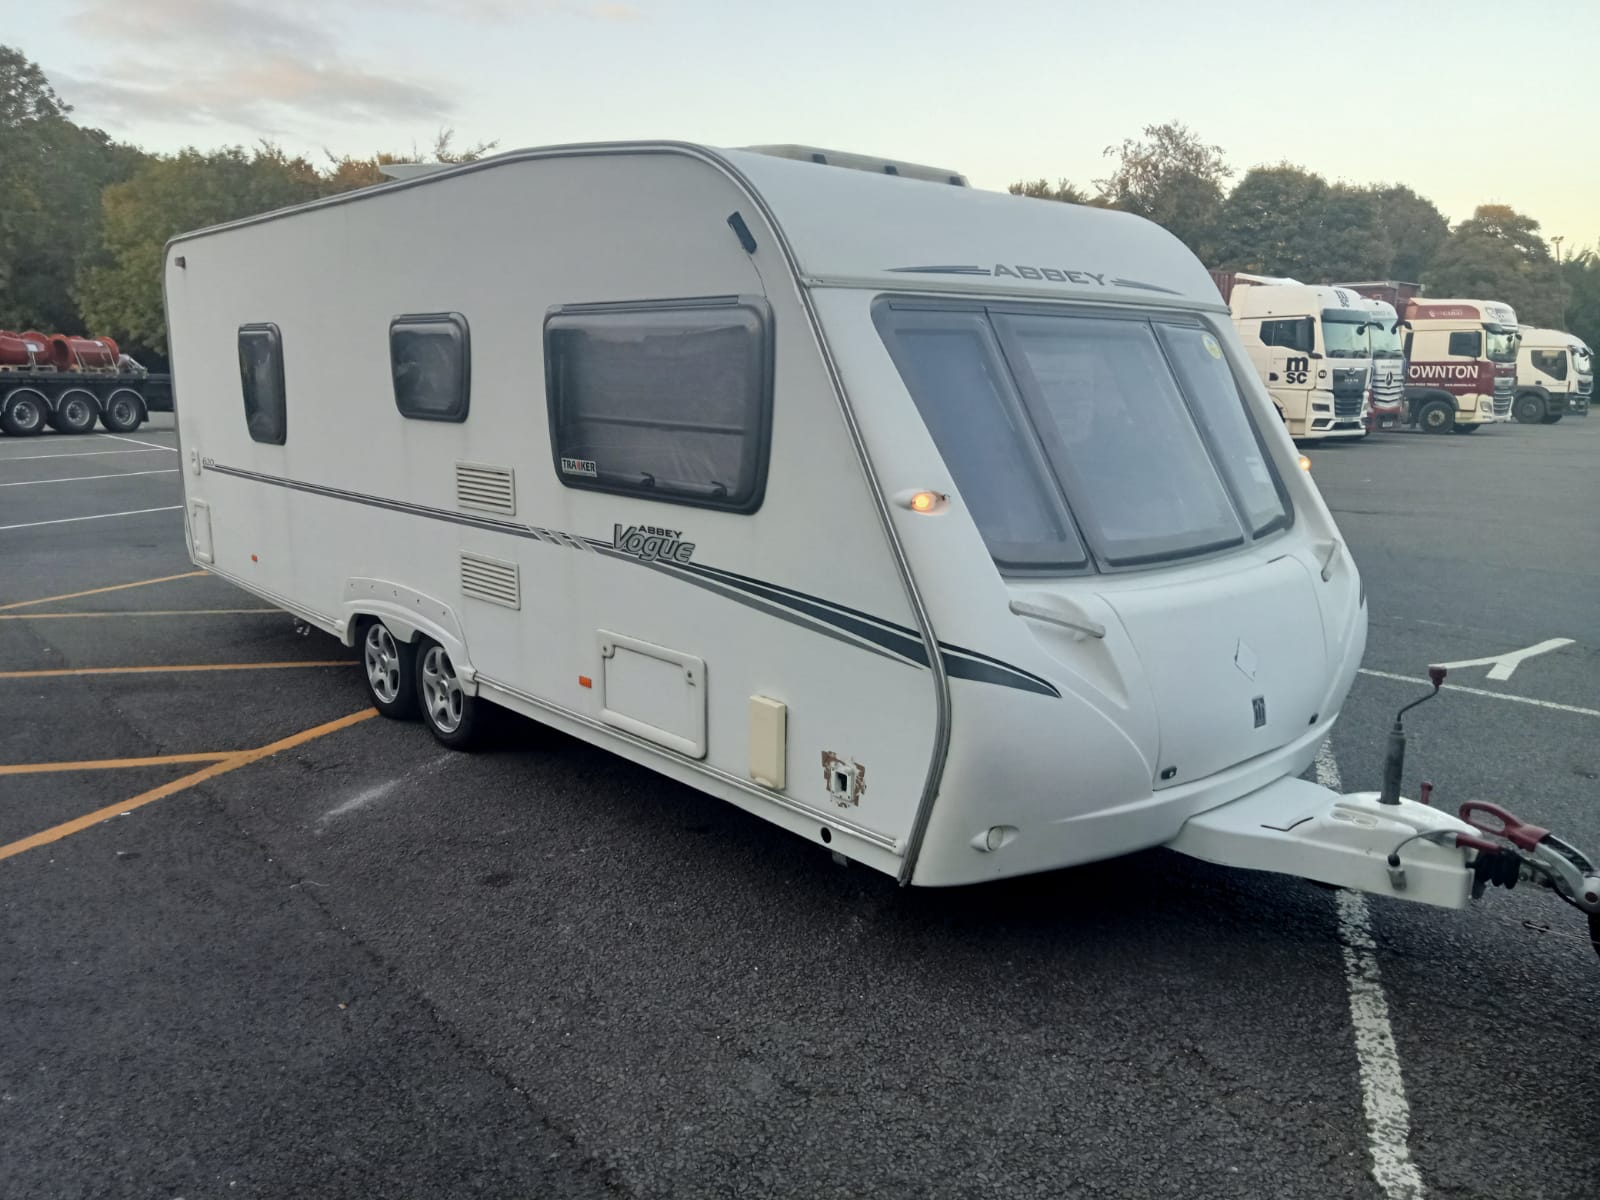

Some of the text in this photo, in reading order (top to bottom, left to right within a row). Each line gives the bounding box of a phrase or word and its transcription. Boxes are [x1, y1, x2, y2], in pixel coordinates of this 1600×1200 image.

[993, 263, 1105, 286] ABBEY
[1286, 356, 1309, 372] m
[1286, 372, 1308, 384] sc
[1407, 365, 1479, 379] OWNTON
[638, 525, 684, 539] ABBEY
